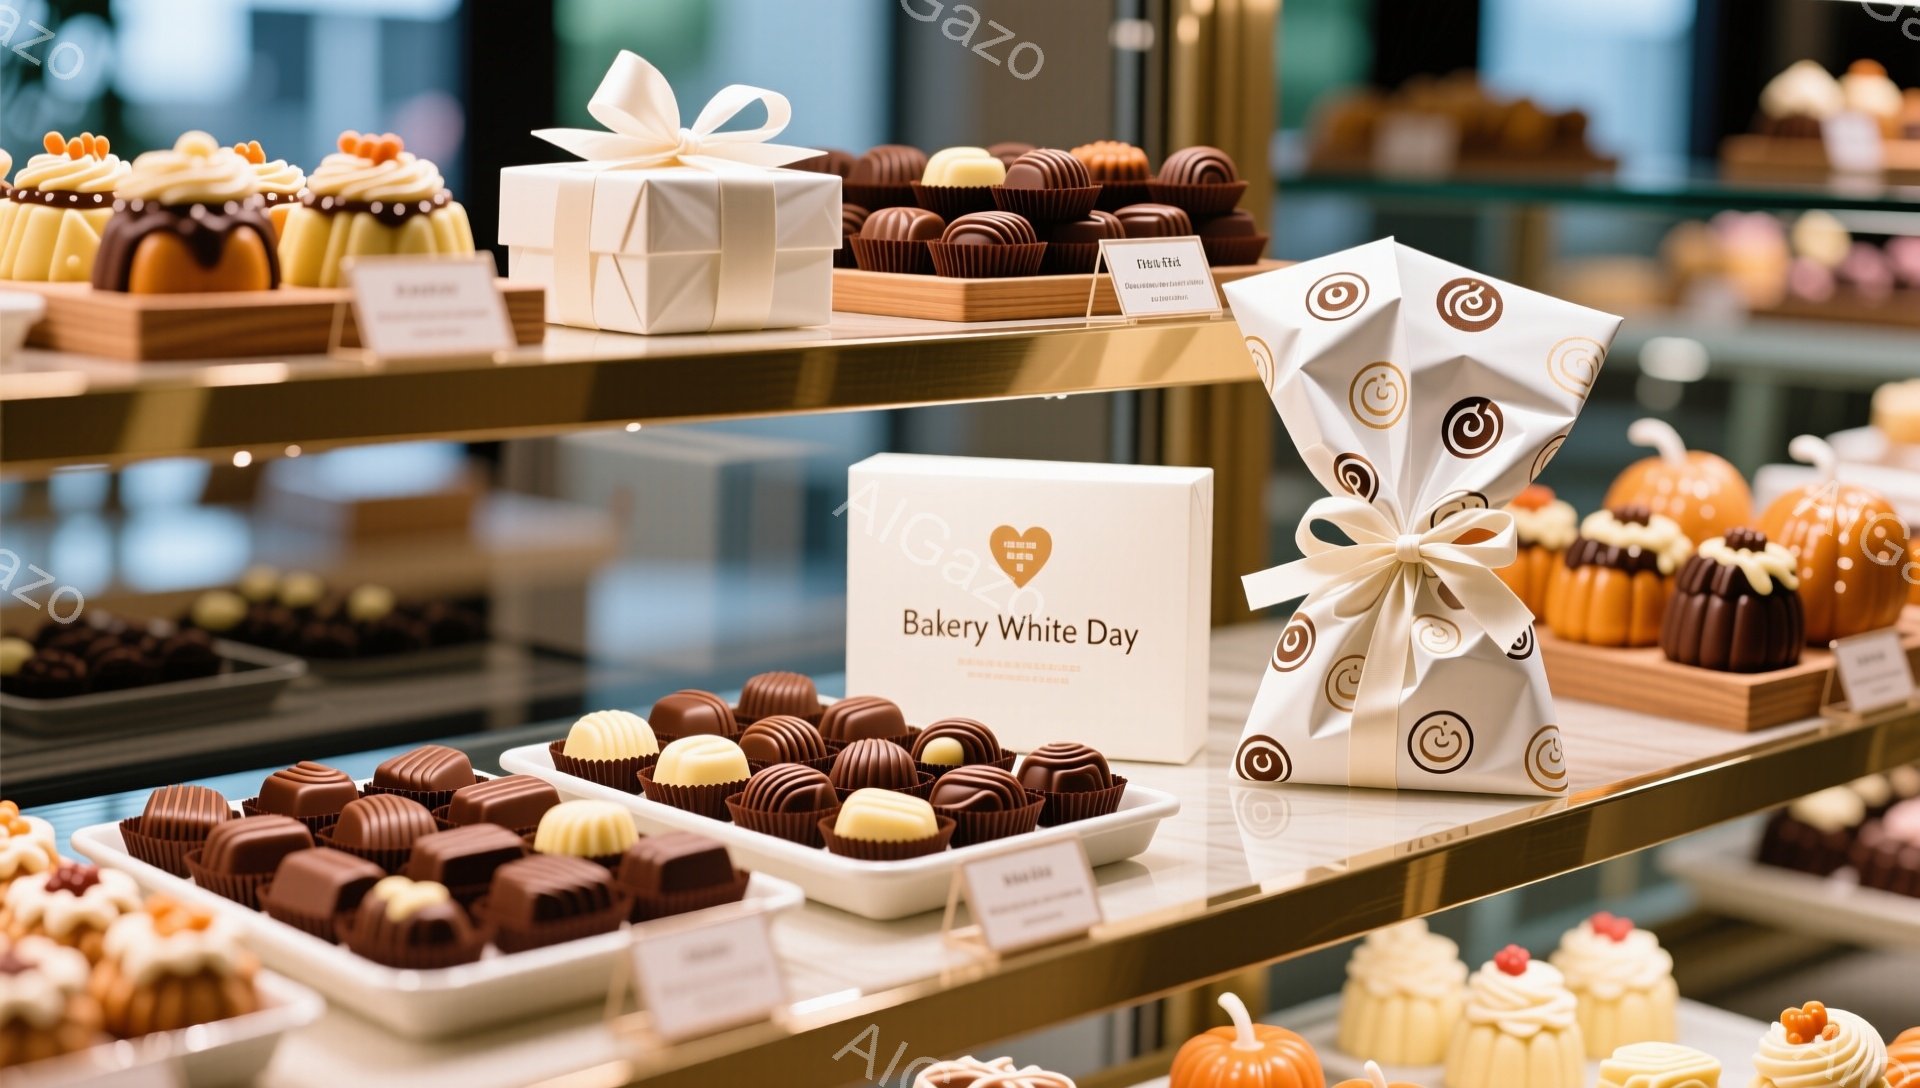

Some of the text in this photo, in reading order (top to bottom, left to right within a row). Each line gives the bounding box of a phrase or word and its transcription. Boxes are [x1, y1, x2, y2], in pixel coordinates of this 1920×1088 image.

[903, 609, 1139, 655] Bakery White Day
